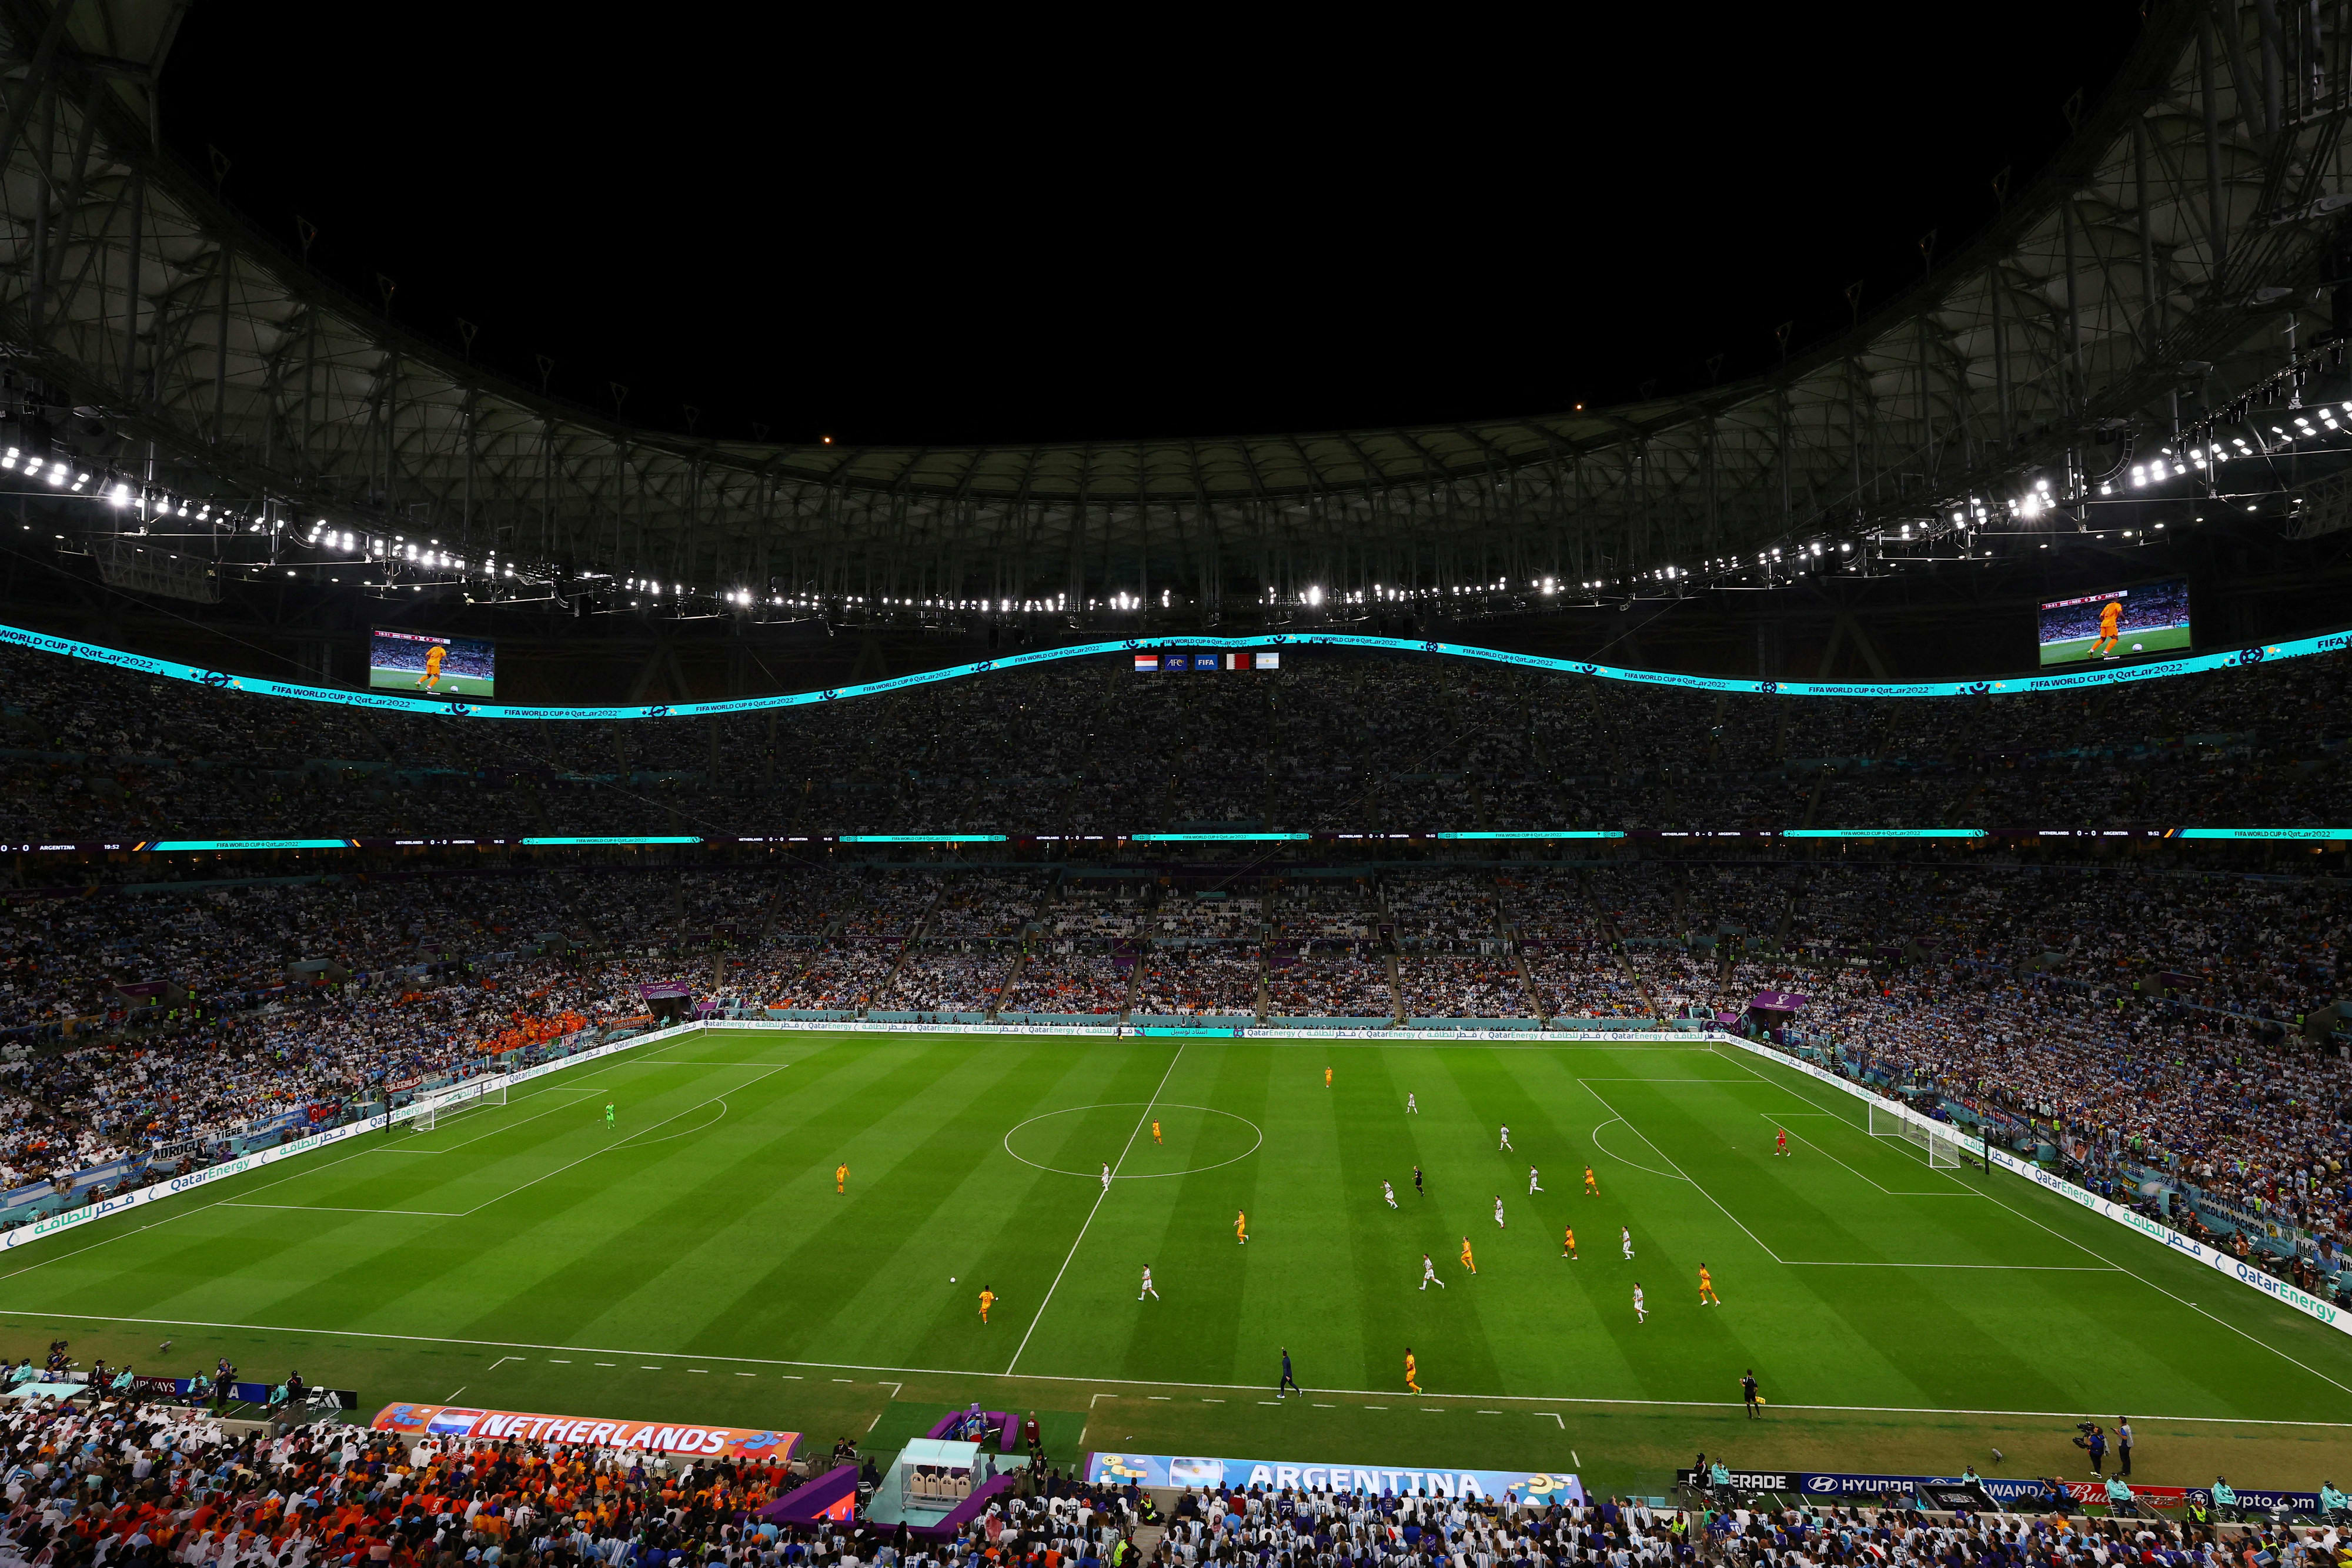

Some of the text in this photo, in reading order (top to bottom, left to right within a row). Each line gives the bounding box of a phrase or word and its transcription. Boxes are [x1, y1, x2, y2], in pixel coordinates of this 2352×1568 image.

[0, 629, 42, 645] WORLD
[45, 640, 68, 652] CUP
[2317, 638, 2346, 650] FIFA
[1027, 652, 1047, 660] WORLD
[1476, 650, 1496, 658] WORLD
[1167, 658, 1183, 667] AFC
[877, 681, 897, 690] WORLD
[2030, 679, 2051, 688] FIFA
[2052, 675, 2085, 687] WORLD
[2087, 673, 2106, 682] CUP
[272, 686, 292, 694] FIFA
[294, 688, 326, 698] WORLD
[329, 692, 346, 700] CUP
[711, 703, 734, 711] WORLD
[808, 1022, 851, 1031] QatarEnergy
[917, 1024, 961, 1034] QatarEnergy
[1029, 1027, 1075, 1035] QatarEnergy
[1248, 1029, 1295, 1038] QatarEnergy
[1367, 1031, 1415, 1039] QatarEnergy
[1489, 1032, 1538, 1041] QatarEnergy
[1612, 1033, 1662, 1042] QatarEnergy
[614, 1035, 649, 1051] QatarEnergy
[1729, 1035, 1759, 1055] QatarEnergy
[509, 1065, 549, 1083] QatarEnergy
[1813, 1067, 1843, 1088] QatarEnergy
[215, 1126, 243, 1141] TIGRE
[152, 1138, 208, 1160] ADROGU
[171, 1158, 250, 1191] QatarEnergy
[2035, 1169, 2095, 1208] QatarEnergy
[34, 1192, 135, 1235] قطر للطاقة
[2199, 1202, 2265, 1238] NICOLAS PACHECO
[2123, 1209, 2201, 1257] قطر للطاقة
[2236, 1262, 2336, 1323] QatarEnergy
[478, 1414, 730, 1453] NETHERLANDS
[1247, 1464, 1486, 1499] ARGENTINA
[432, 1500, 440, 1512] 9
[1067, 1505, 1078, 1515] 22
